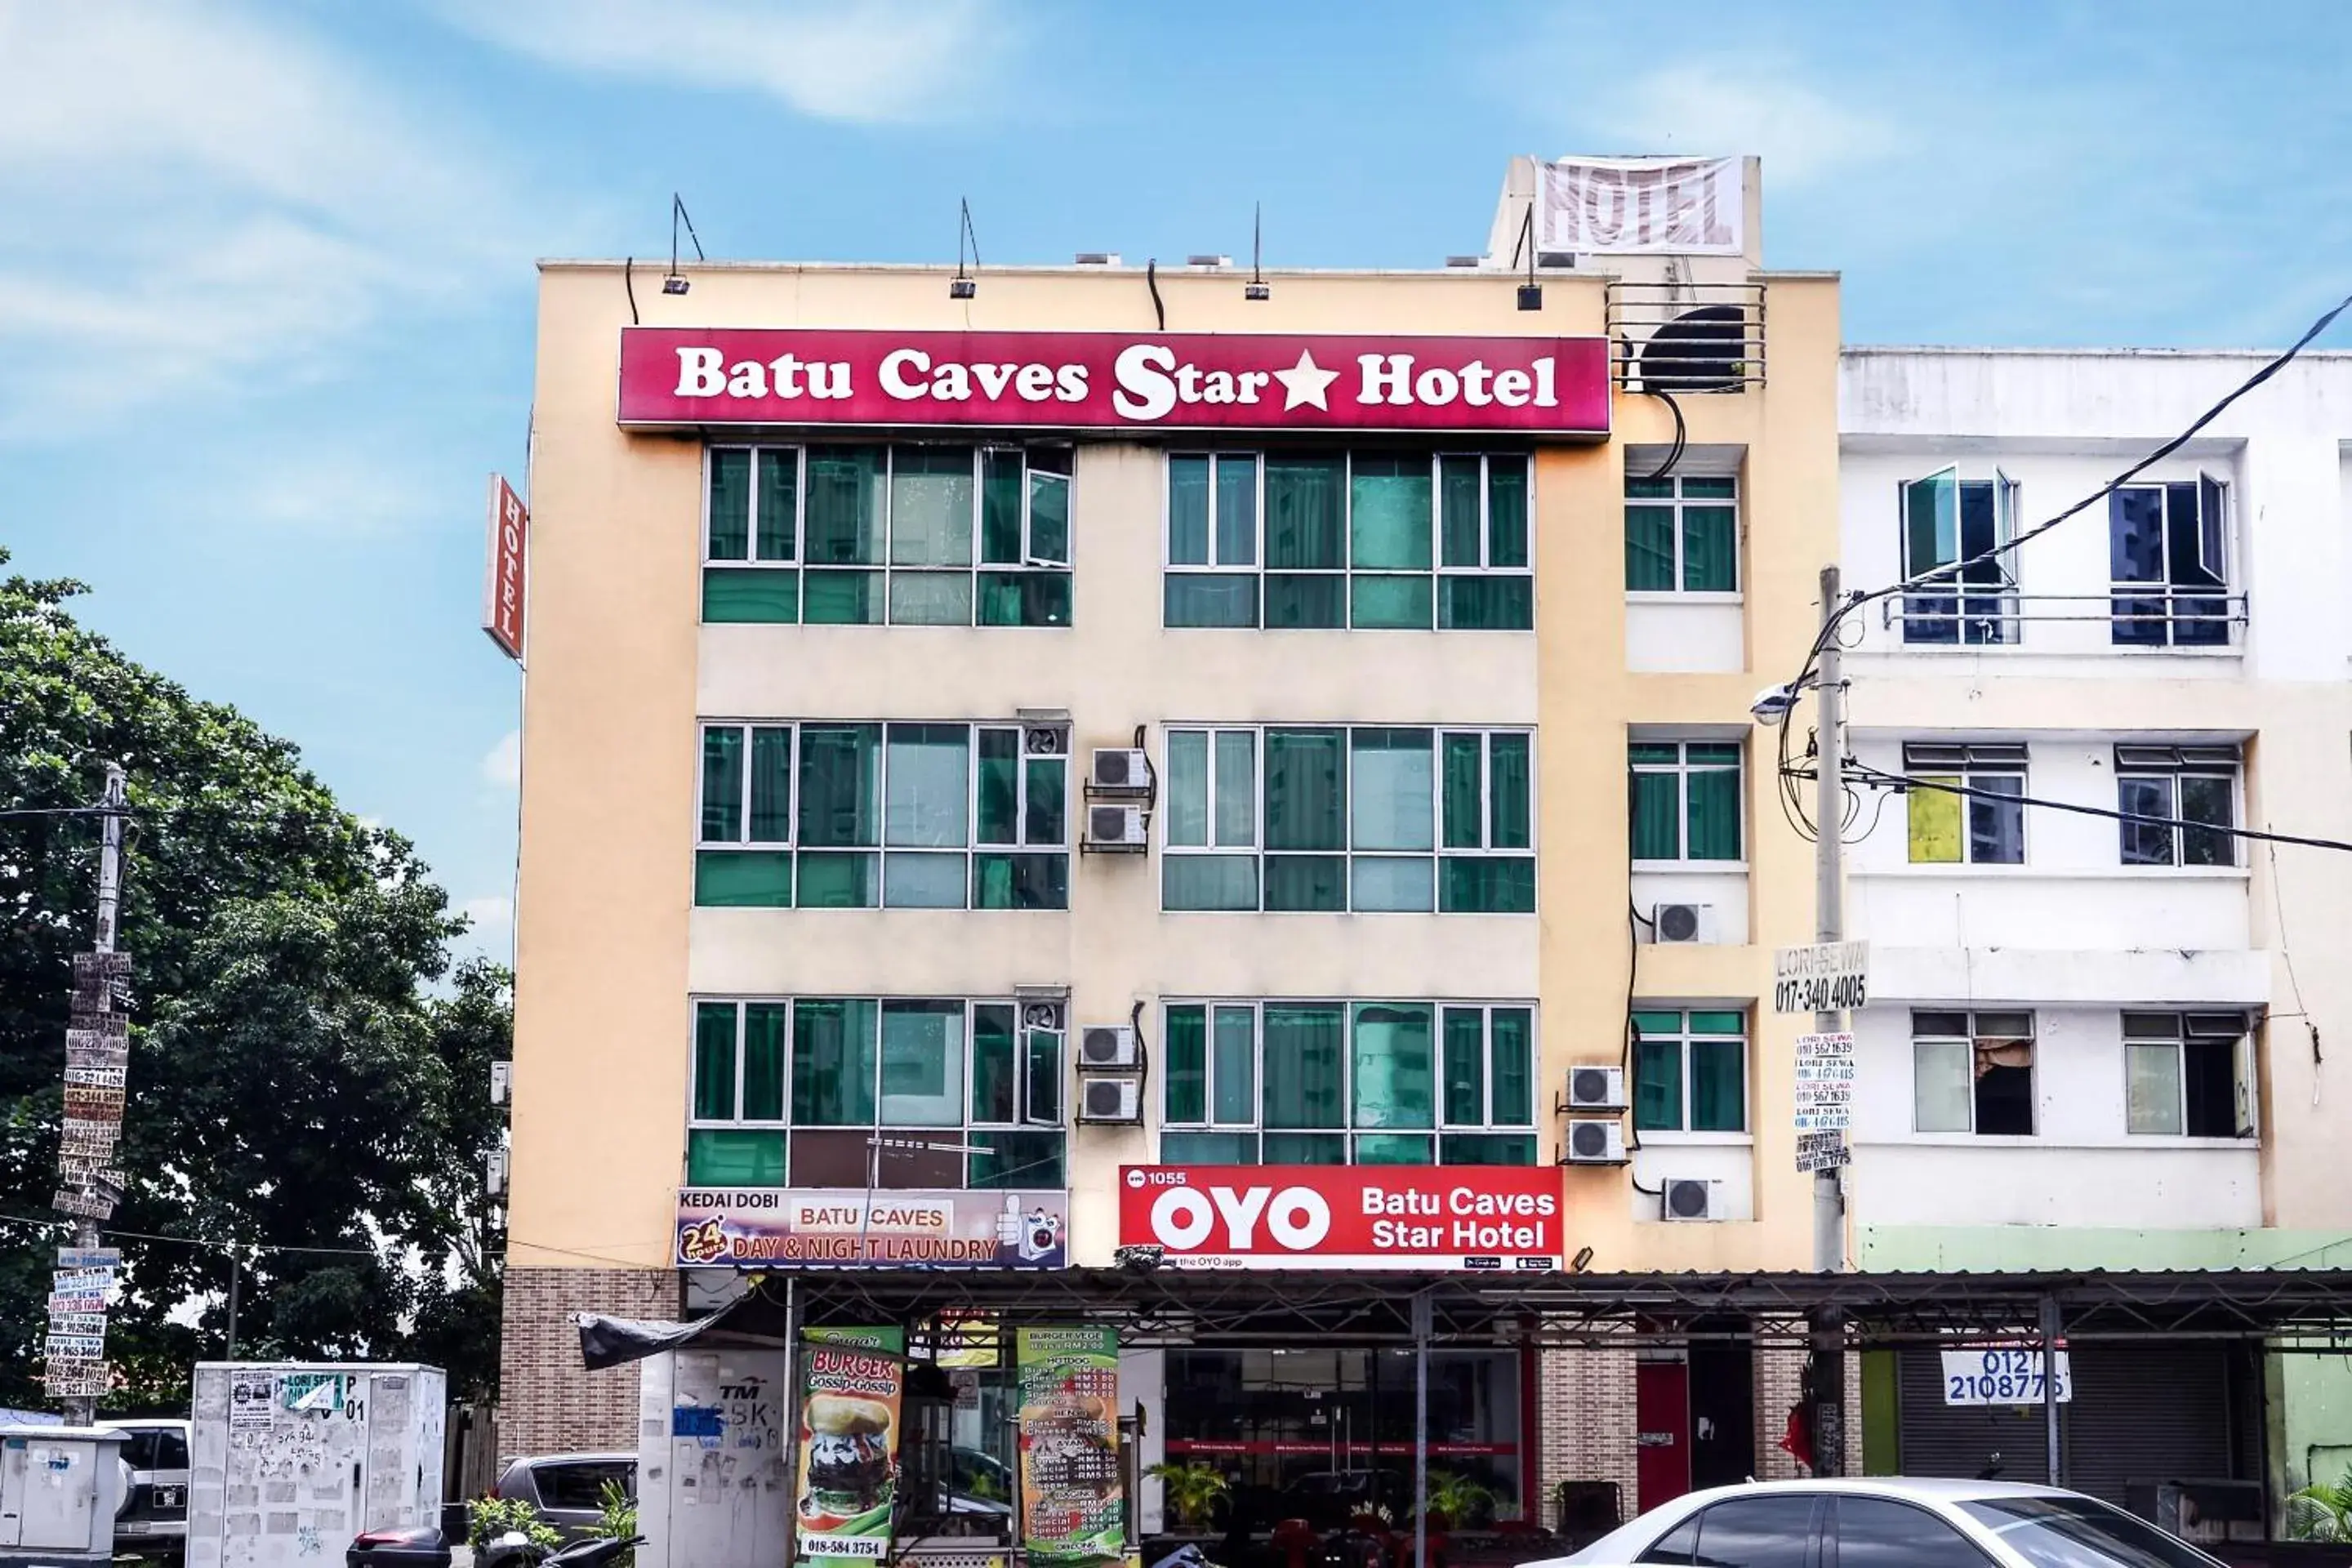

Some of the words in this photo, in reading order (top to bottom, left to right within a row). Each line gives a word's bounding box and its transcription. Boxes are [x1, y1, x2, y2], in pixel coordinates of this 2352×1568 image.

[1544, 163, 1733, 246] HOTEL
[673, 346, 853, 399] Batu
[878, 347, 1089, 401] Caves
[1112, 344, 1270, 421] Star
[1355, 354, 1558, 408] Hotel
[502, 492, 520, 639] HOTEL
[1777, 947, 1814, 977] LORI
[1831, 974, 1865, 1009] 4005
[1148, 1172, 1186, 1184] 1055
[679, 1193, 732, 1209] KEDAI
[736, 1193, 779, 1209] DOBI
[1362, 1187, 1441, 1215] Batu
[1449, 1187, 1555, 1216] Caves
[800, 1208, 858, 1226] BATU
[871, 1209, 943, 1227] CAVES
[1151, 1186, 1330, 1250] OYO
[684, 1223, 721, 1249] 24
[1372, 1221, 1443, 1248] Star
[1454, 1221, 1544, 1248] Hotel
[688, 1242, 726, 1261] hours
[733, 1238, 781, 1258] DAY
[785, 1238, 801, 1258] &
[808, 1238, 880, 1259] NIGHT
[887, 1238, 997, 1260] LAUNDRY
[1198, 1258, 1221, 1266] OYO
[1223, 1258, 1242, 1267] app
[1030, 1332, 1072, 1340] BURGER
[1073, 1332, 1102, 1340] VEGE
[812, 1350, 894, 1379] BURGER
[1982, 1350, 2029, 1374] 012
[287, 1374, 311, 1387] LORI
[808, 1375, 897, 1396] Gossip-Gossip
[719, 1385, 761, 1400] TM
[50, 1460, 69, 1471] TM
[808, 1539, 849, 1553] 018-584
[853, 1542, 880, 1554] 3754
